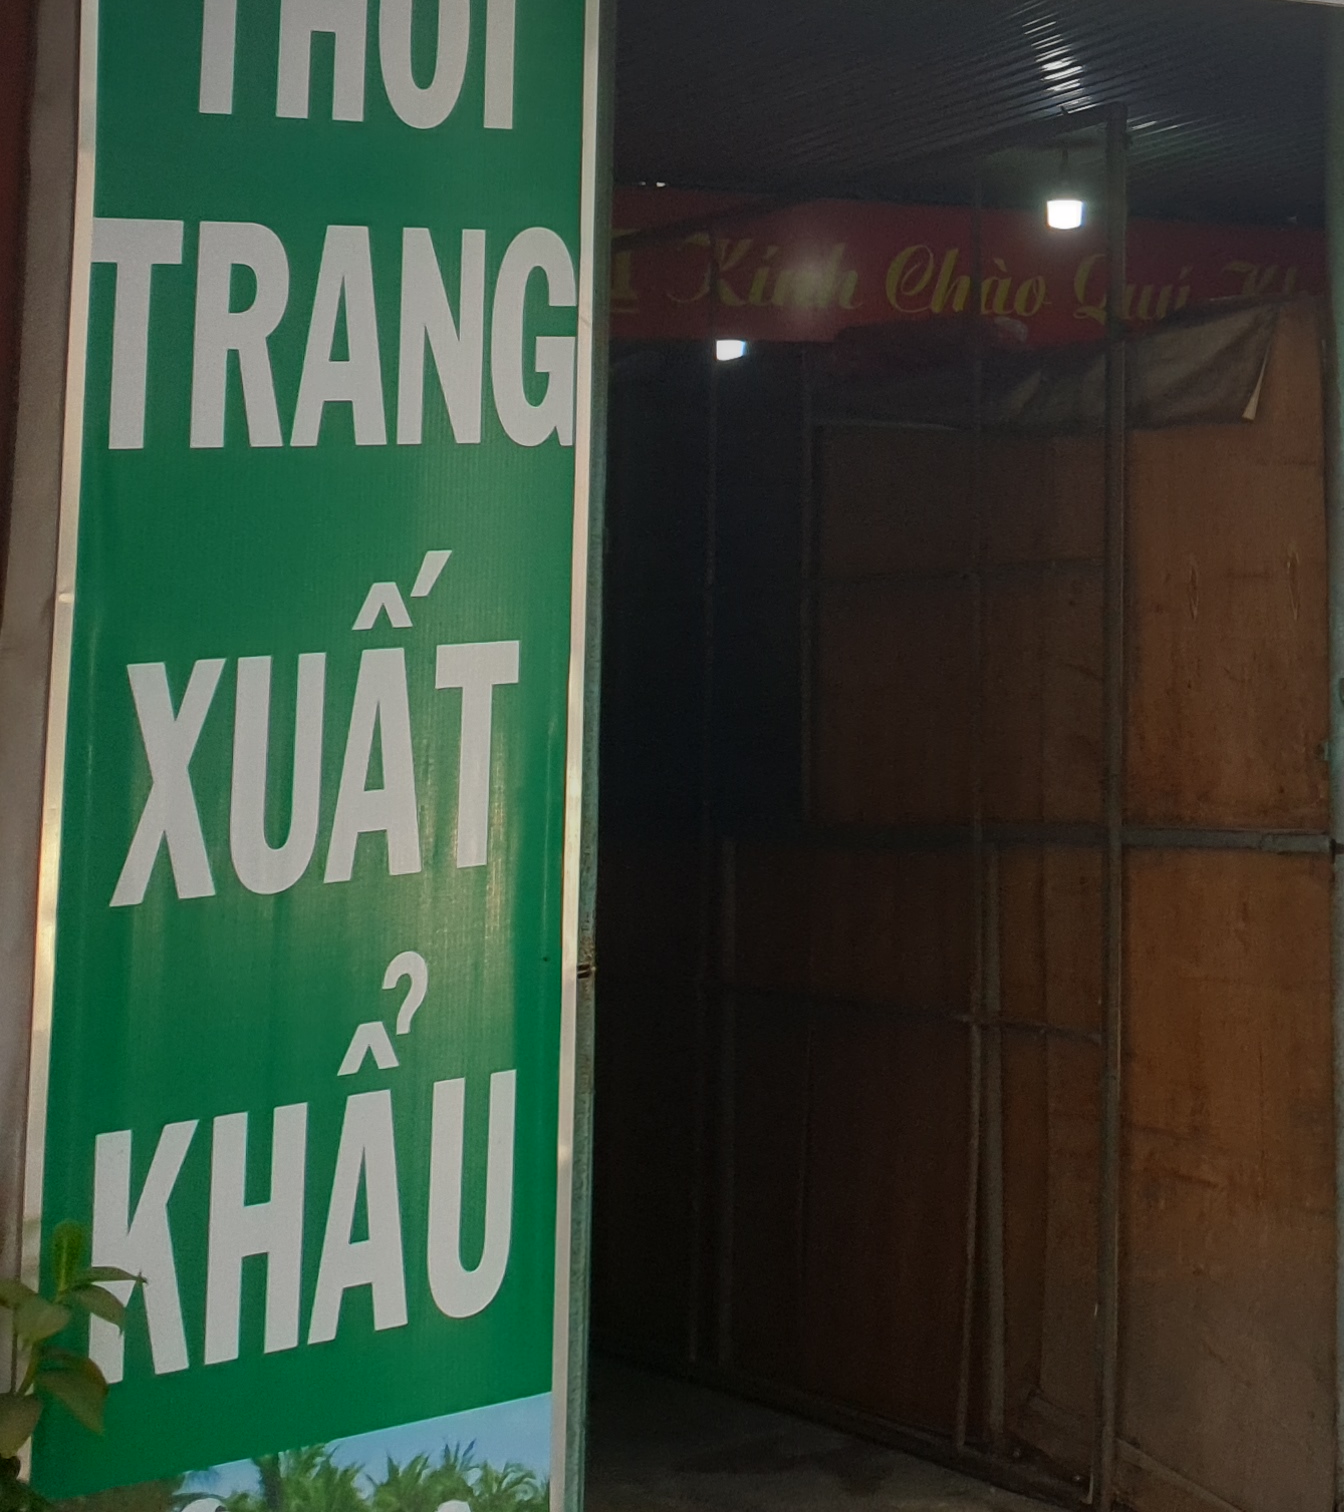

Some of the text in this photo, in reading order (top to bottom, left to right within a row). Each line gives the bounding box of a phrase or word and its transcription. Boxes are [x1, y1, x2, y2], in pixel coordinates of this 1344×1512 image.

[91, 218, 577, 449] TRANG
[885, 244, 1048, 318] Chào
[109, 550, 520, 908] XUẤT
[88, 951, 519, 1386] KHẨU
